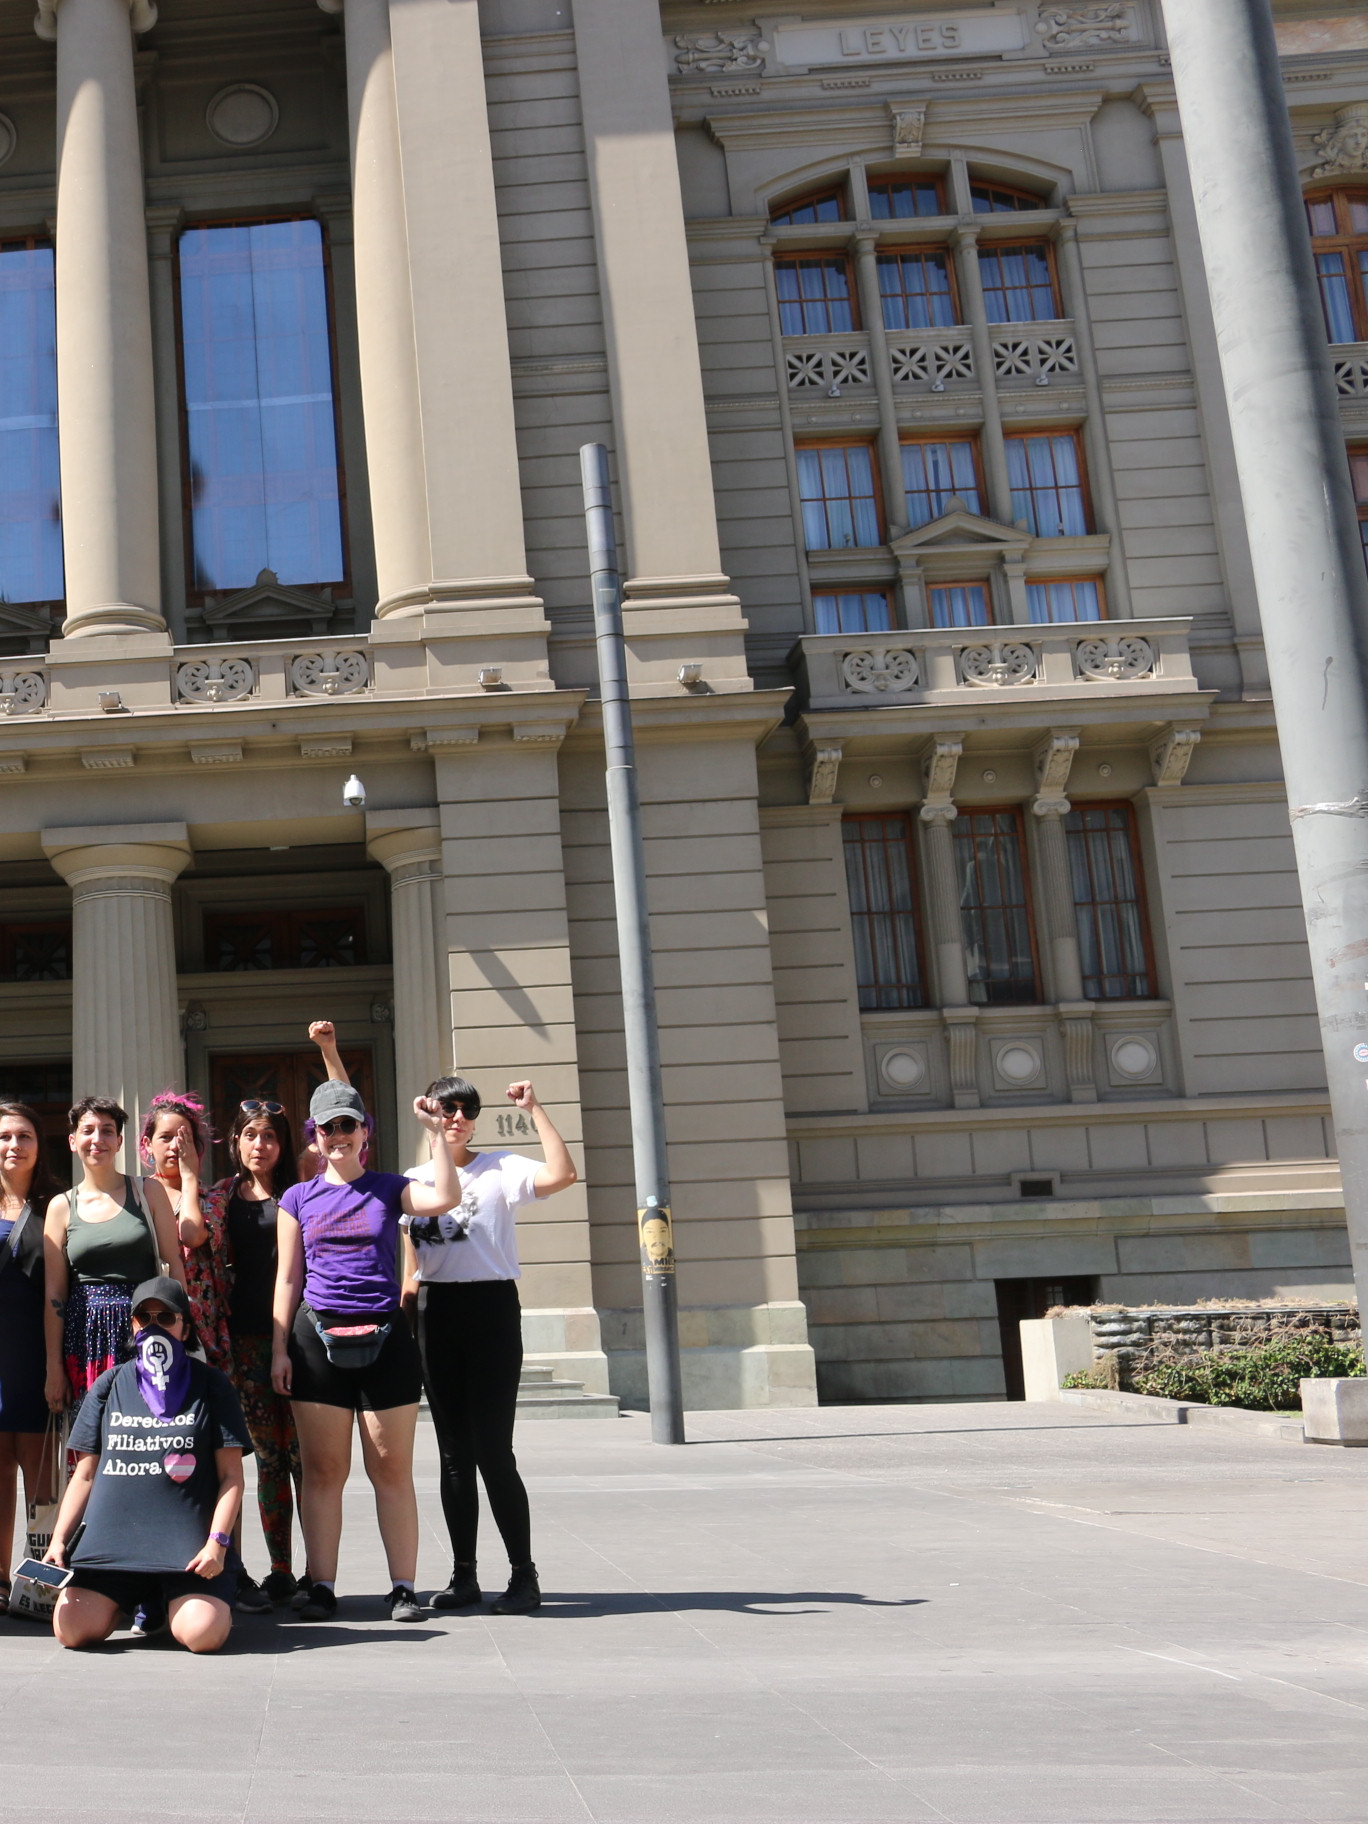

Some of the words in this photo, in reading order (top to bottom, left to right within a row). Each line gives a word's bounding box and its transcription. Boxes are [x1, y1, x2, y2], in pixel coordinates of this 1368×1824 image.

[839, 21, 961, 57] LEYES
[110, 1412, 195, 1428] Derecos
[107, 1434, 194, 1451] Filiativos
[102, 1459, 162, 1476] Ahora
